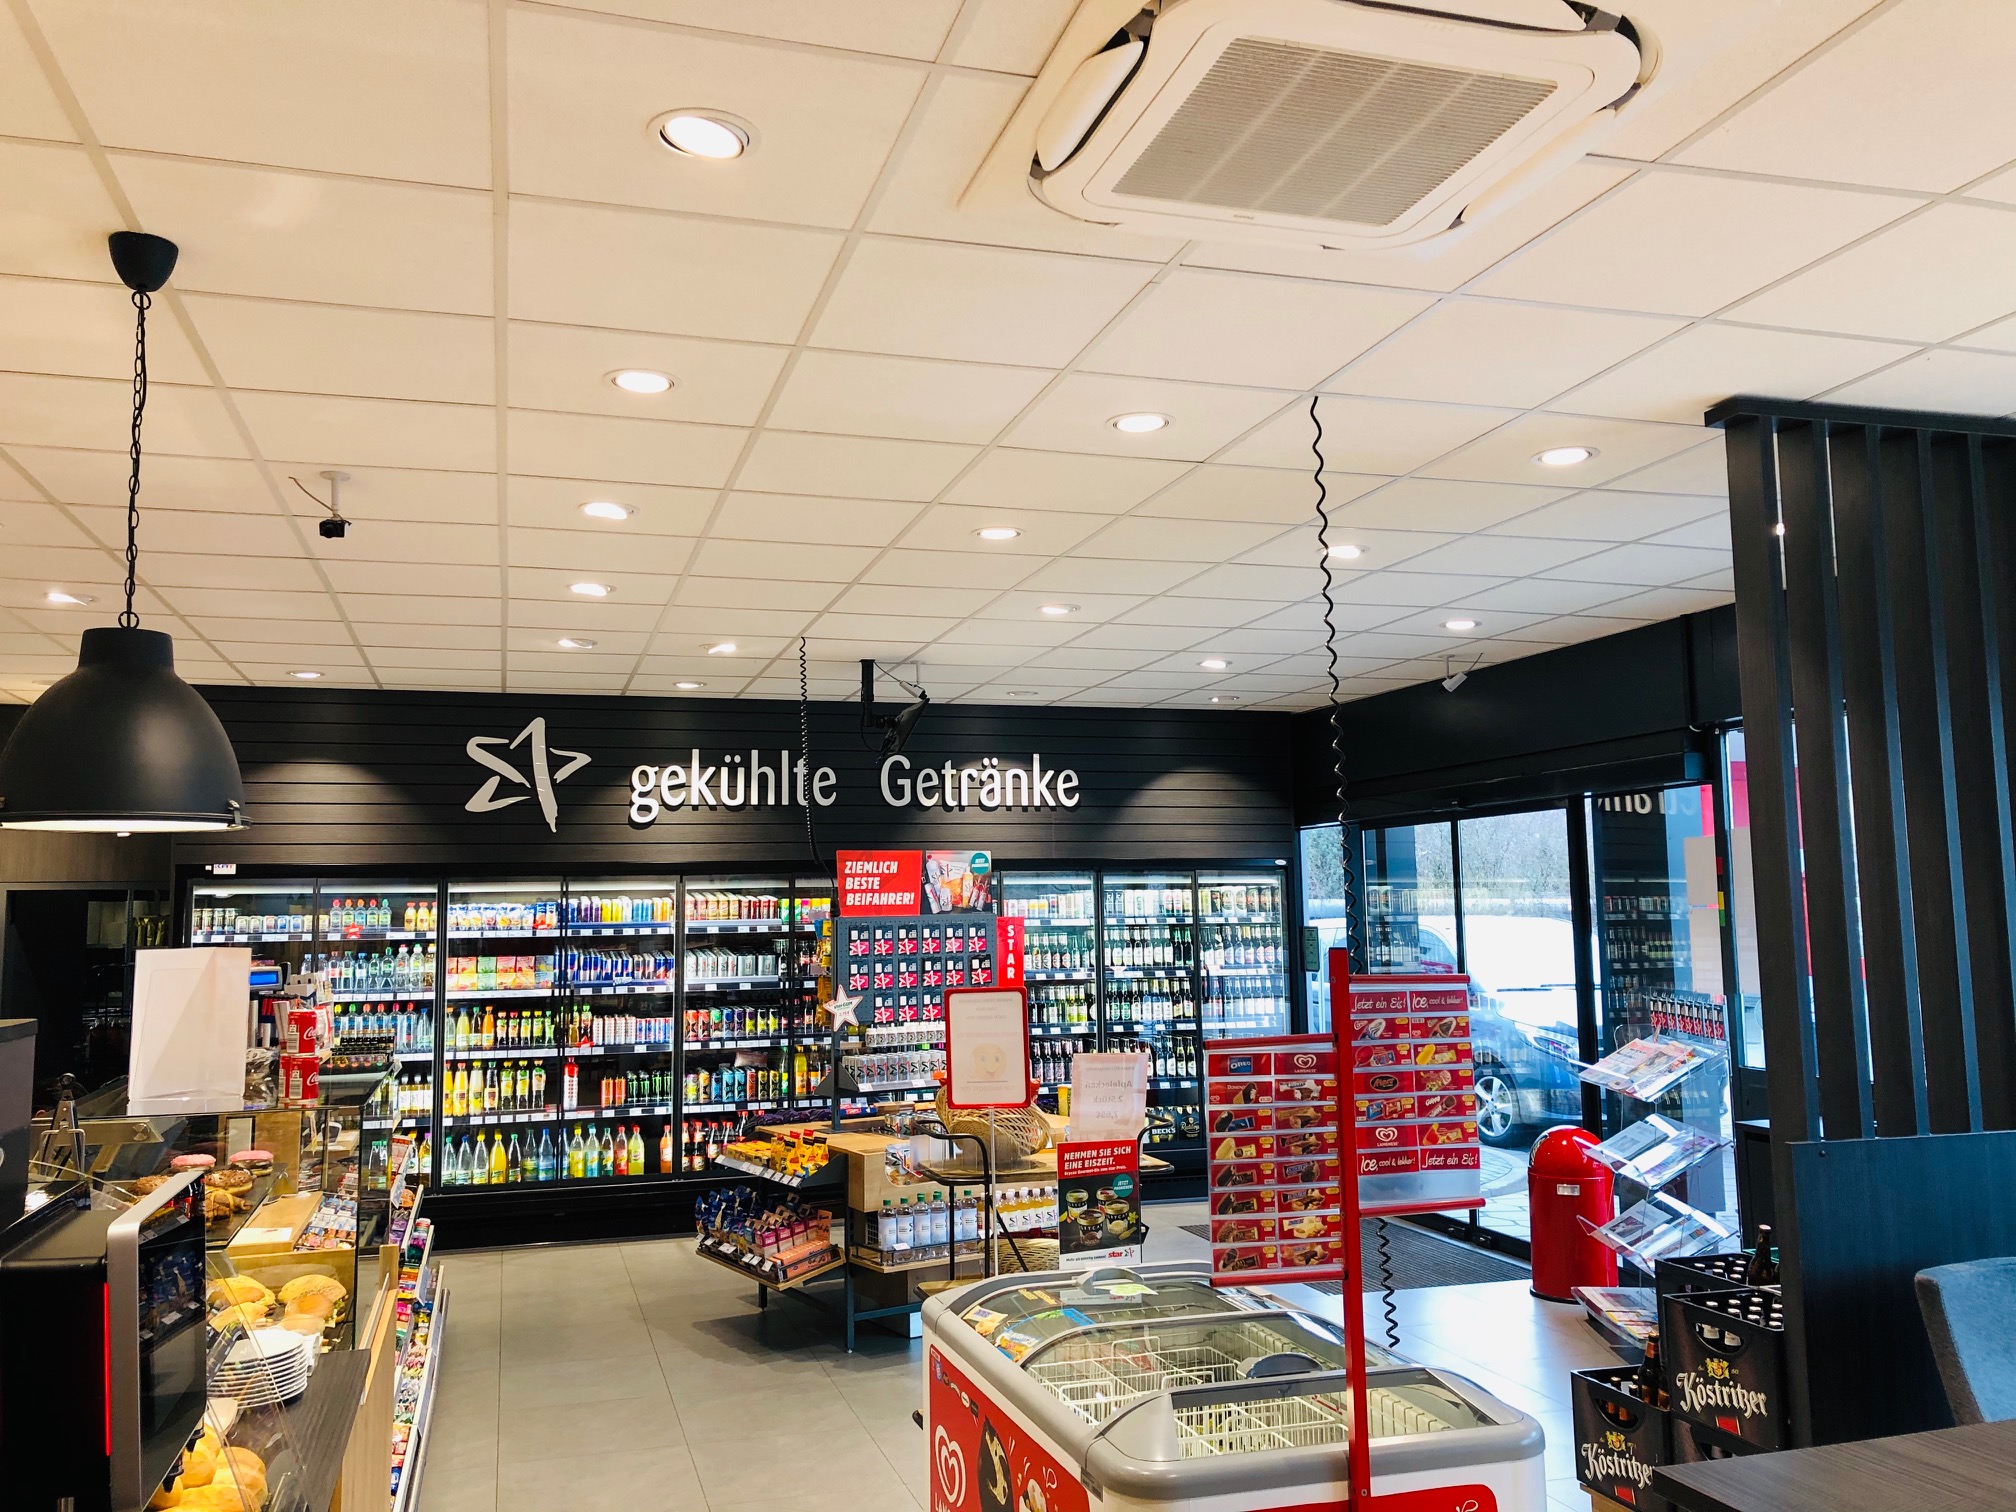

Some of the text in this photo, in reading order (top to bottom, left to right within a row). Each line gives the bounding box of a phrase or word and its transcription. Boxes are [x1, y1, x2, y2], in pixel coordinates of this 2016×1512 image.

[629, 749, 1080, 824] gekühlte Getränke
[844, 861, 899, 874] ZIEMLICH
[845, 877, 881, 890] BESTE
[846, 892, 915, 906] BEIFAHRER!
[1351, 995, 1407, 1012] Jetzt ein Eis!
[1230, 1061, 1251, 1069] OREO
[1064, 1146, 1131, 1161] NEHMEN SIE SICH
[1422, 1151, 1478, 1168] Jetzt ein Eis!
[1064, 1157, 1116, 1170] EINE EISZEIT.
[1379, 1157, 1391, 1166] cool
[1107, 1250, 1123, 1259] star
